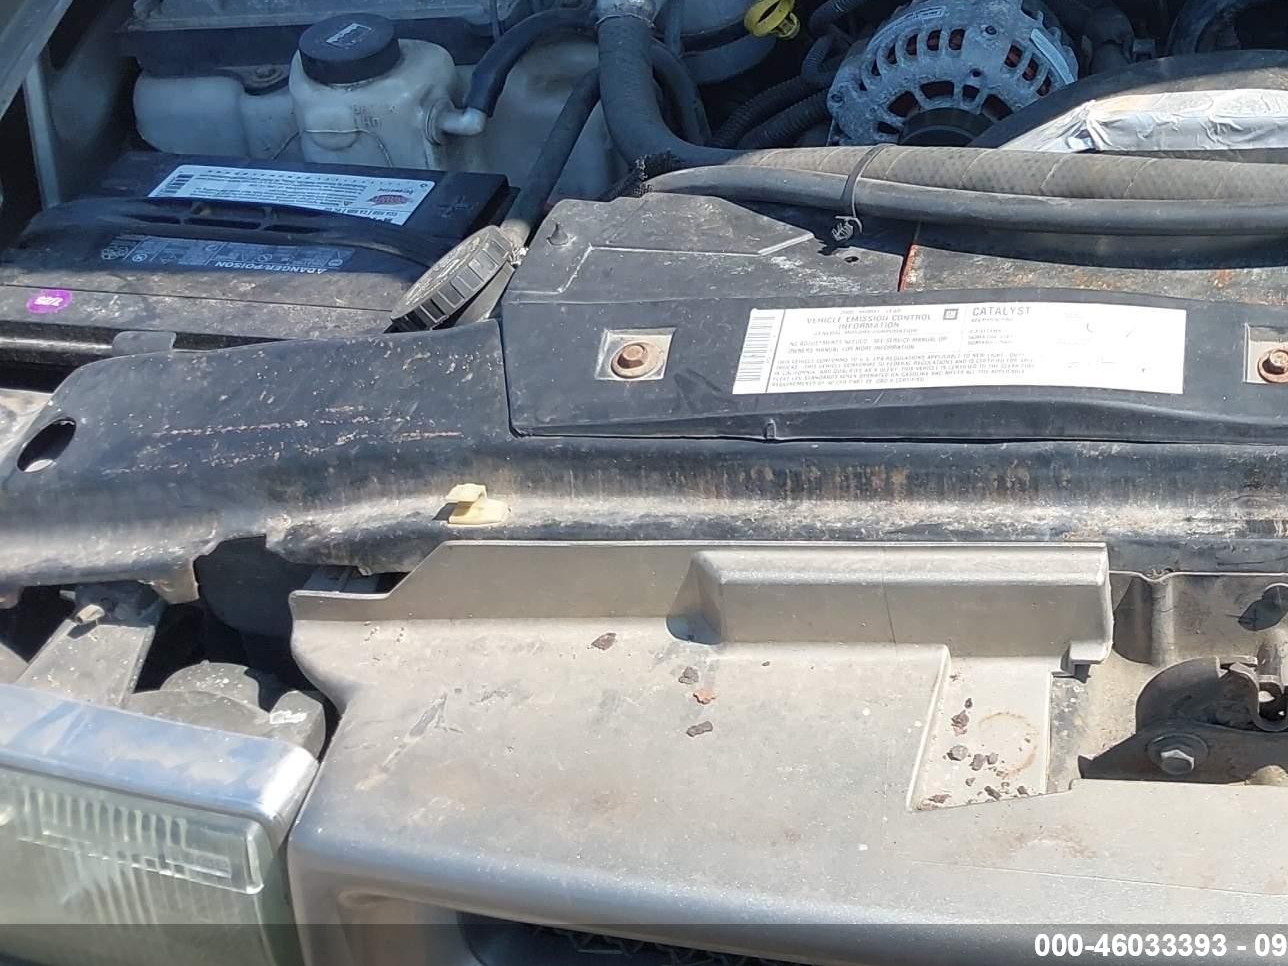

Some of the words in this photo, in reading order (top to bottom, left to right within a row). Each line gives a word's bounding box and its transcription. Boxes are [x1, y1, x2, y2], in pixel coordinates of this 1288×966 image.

[972, 306, 1032, 317] CATALYST
[807, 316, 841, 324] VEHICLE
[846, 315, 888, 323] EMISSION
[838, 322, 900, 330] INFORMATION
